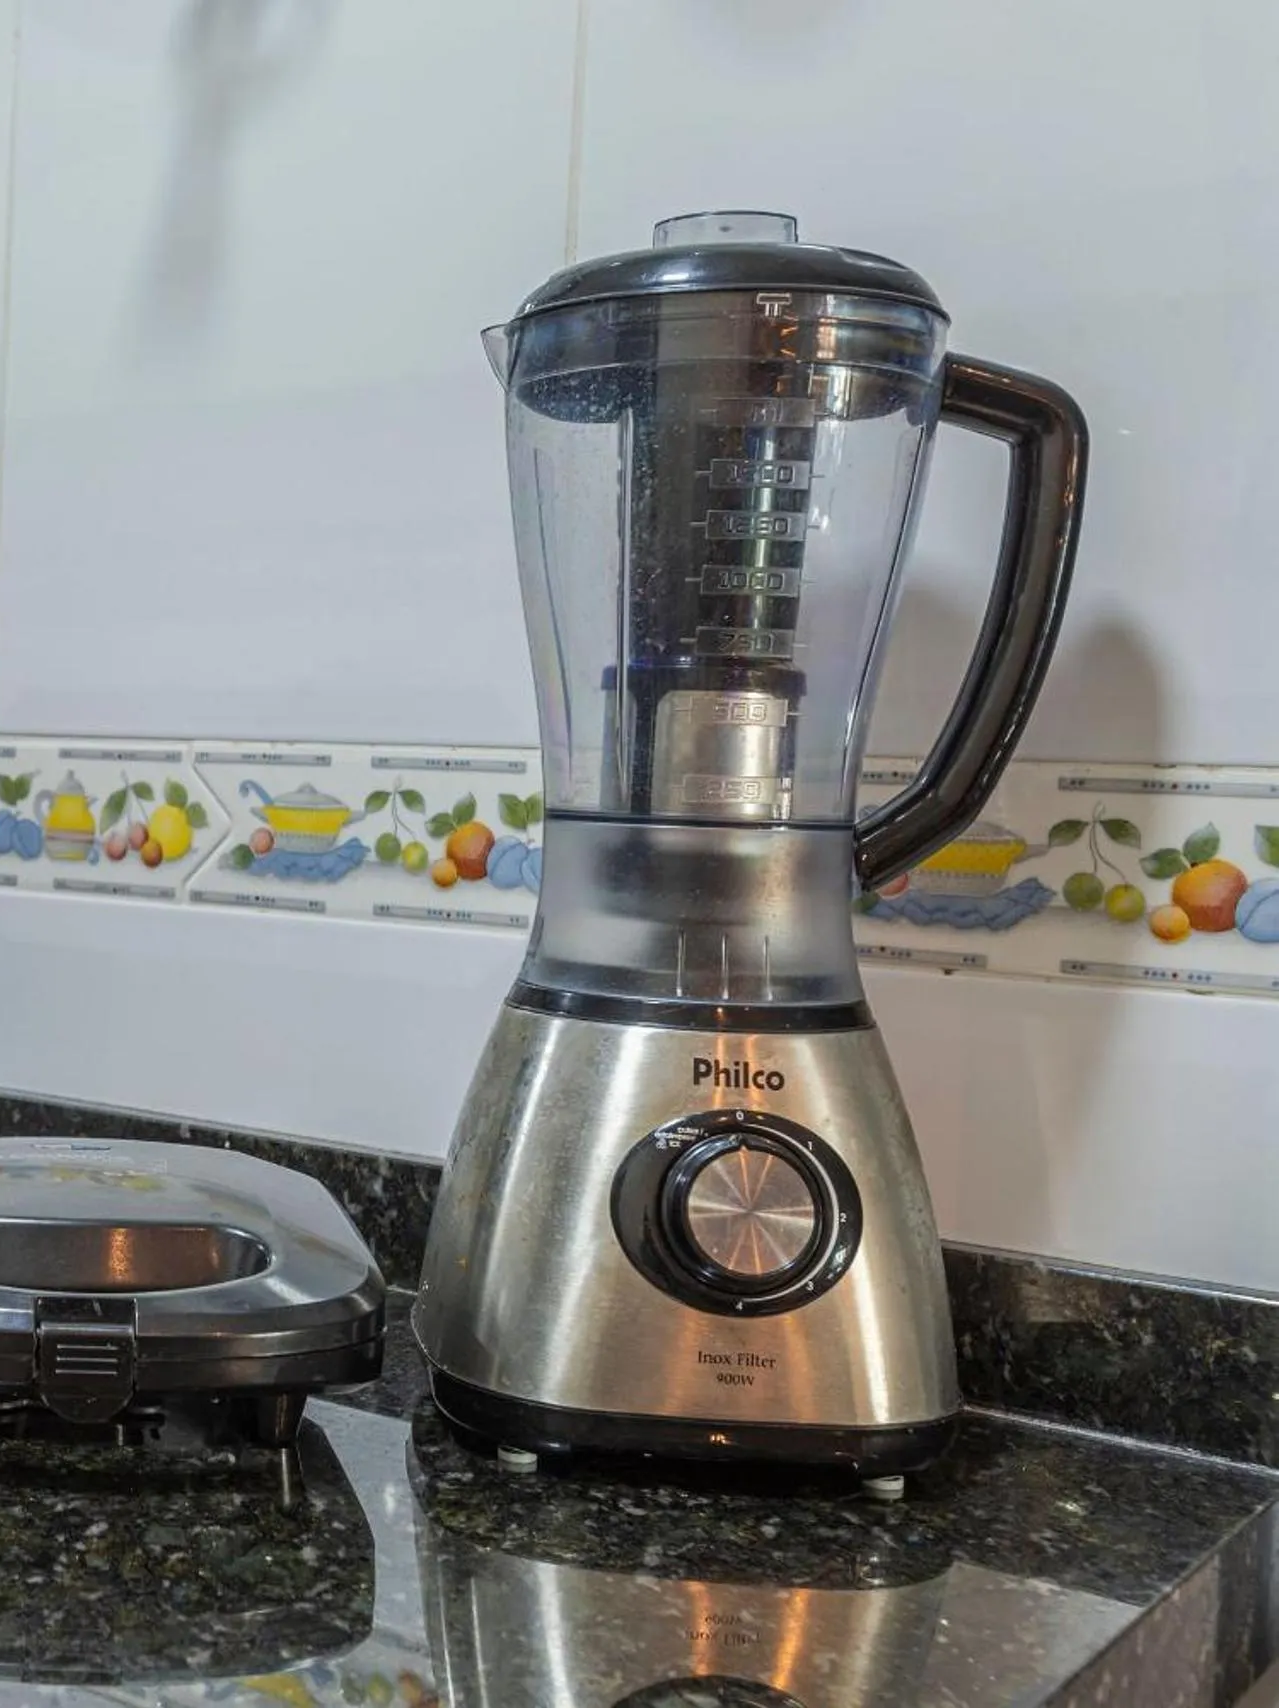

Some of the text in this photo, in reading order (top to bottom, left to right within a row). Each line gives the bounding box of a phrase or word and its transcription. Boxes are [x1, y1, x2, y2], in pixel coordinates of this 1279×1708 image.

[692, 1057, 785, 1091] Philco
[840, 1213, 848, 1224] 2
[806, 1281, 815, 1292] 3
[698, 1350, 777, 1369] Inox Filter
